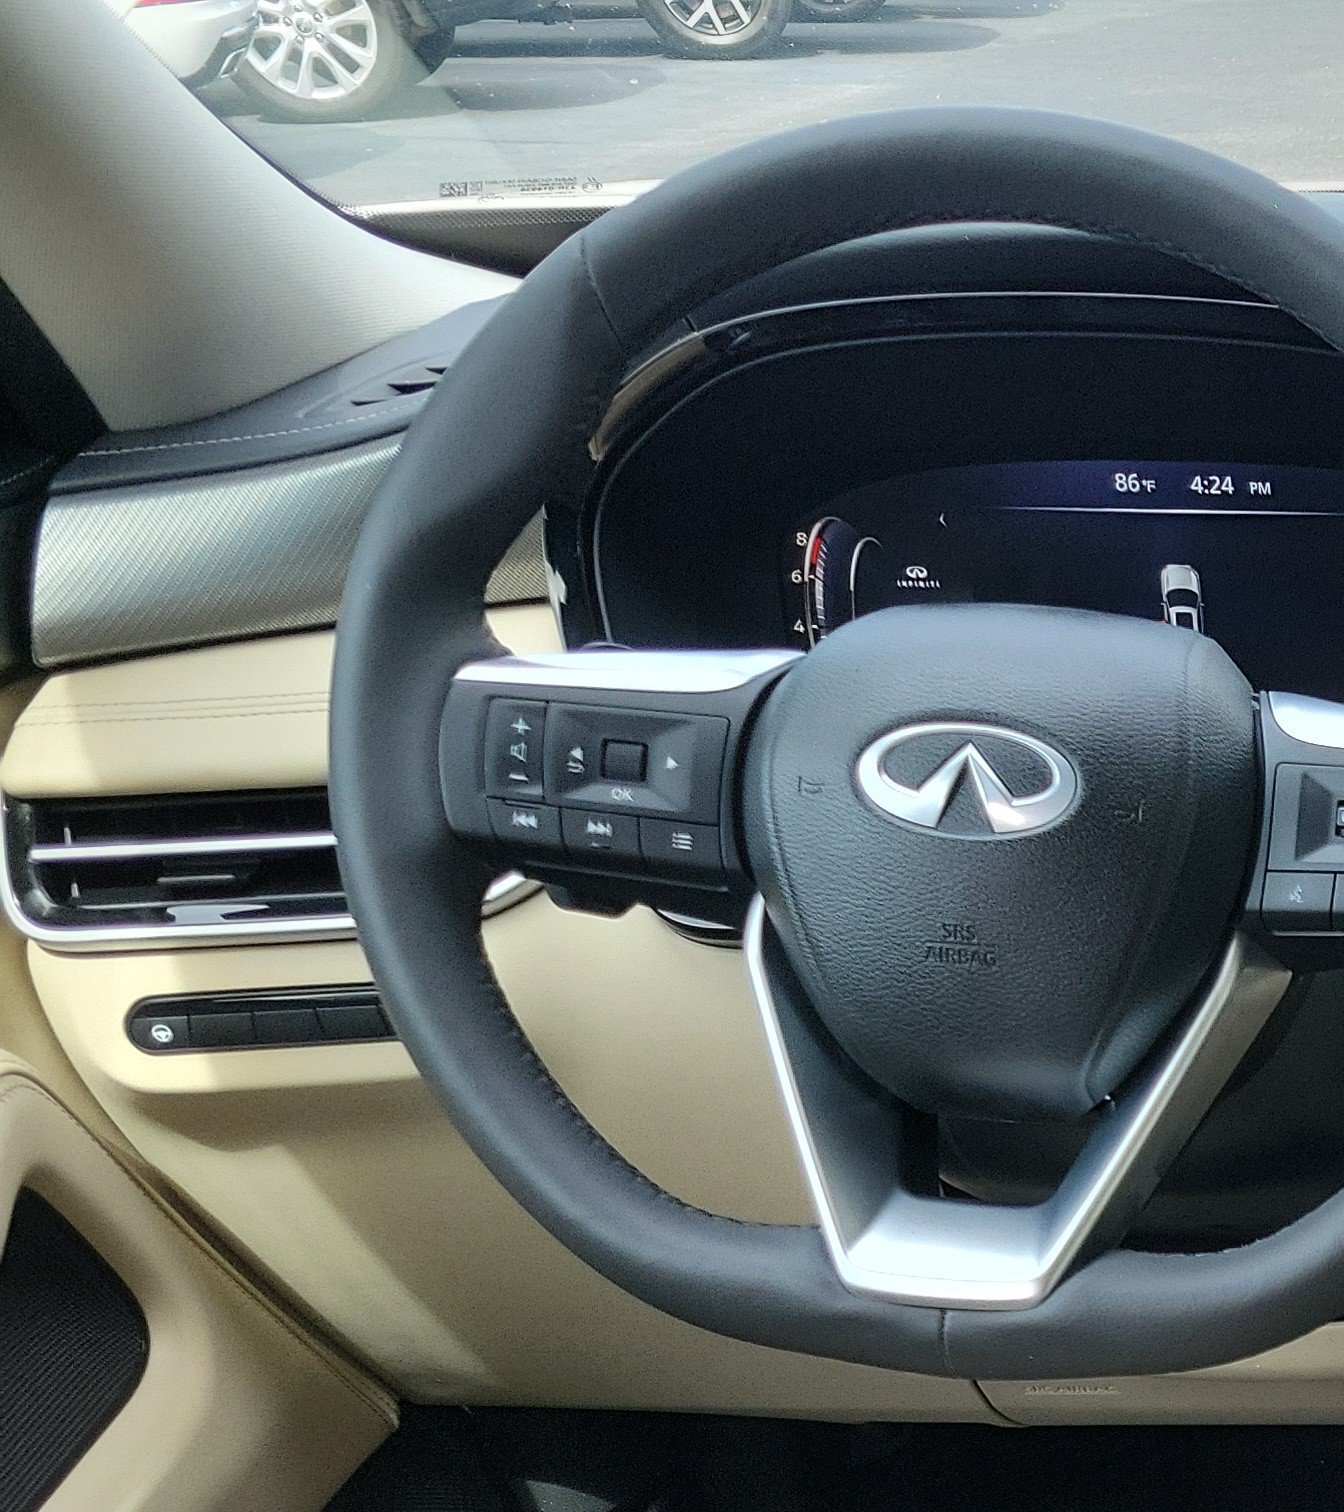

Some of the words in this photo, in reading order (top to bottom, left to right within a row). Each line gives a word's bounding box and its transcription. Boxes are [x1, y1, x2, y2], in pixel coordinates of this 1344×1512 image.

[1114, 472, 1156, 494] 86°F
[1190, 475, 1235, 495] 4:24
[1249, 481, 1272, 495] PM
[796, 532, 807, 547] 8
[790, 569, 803, 583] 6
[793, 618, 806, 634] 4
[941, 923, 976, 940] SRS
